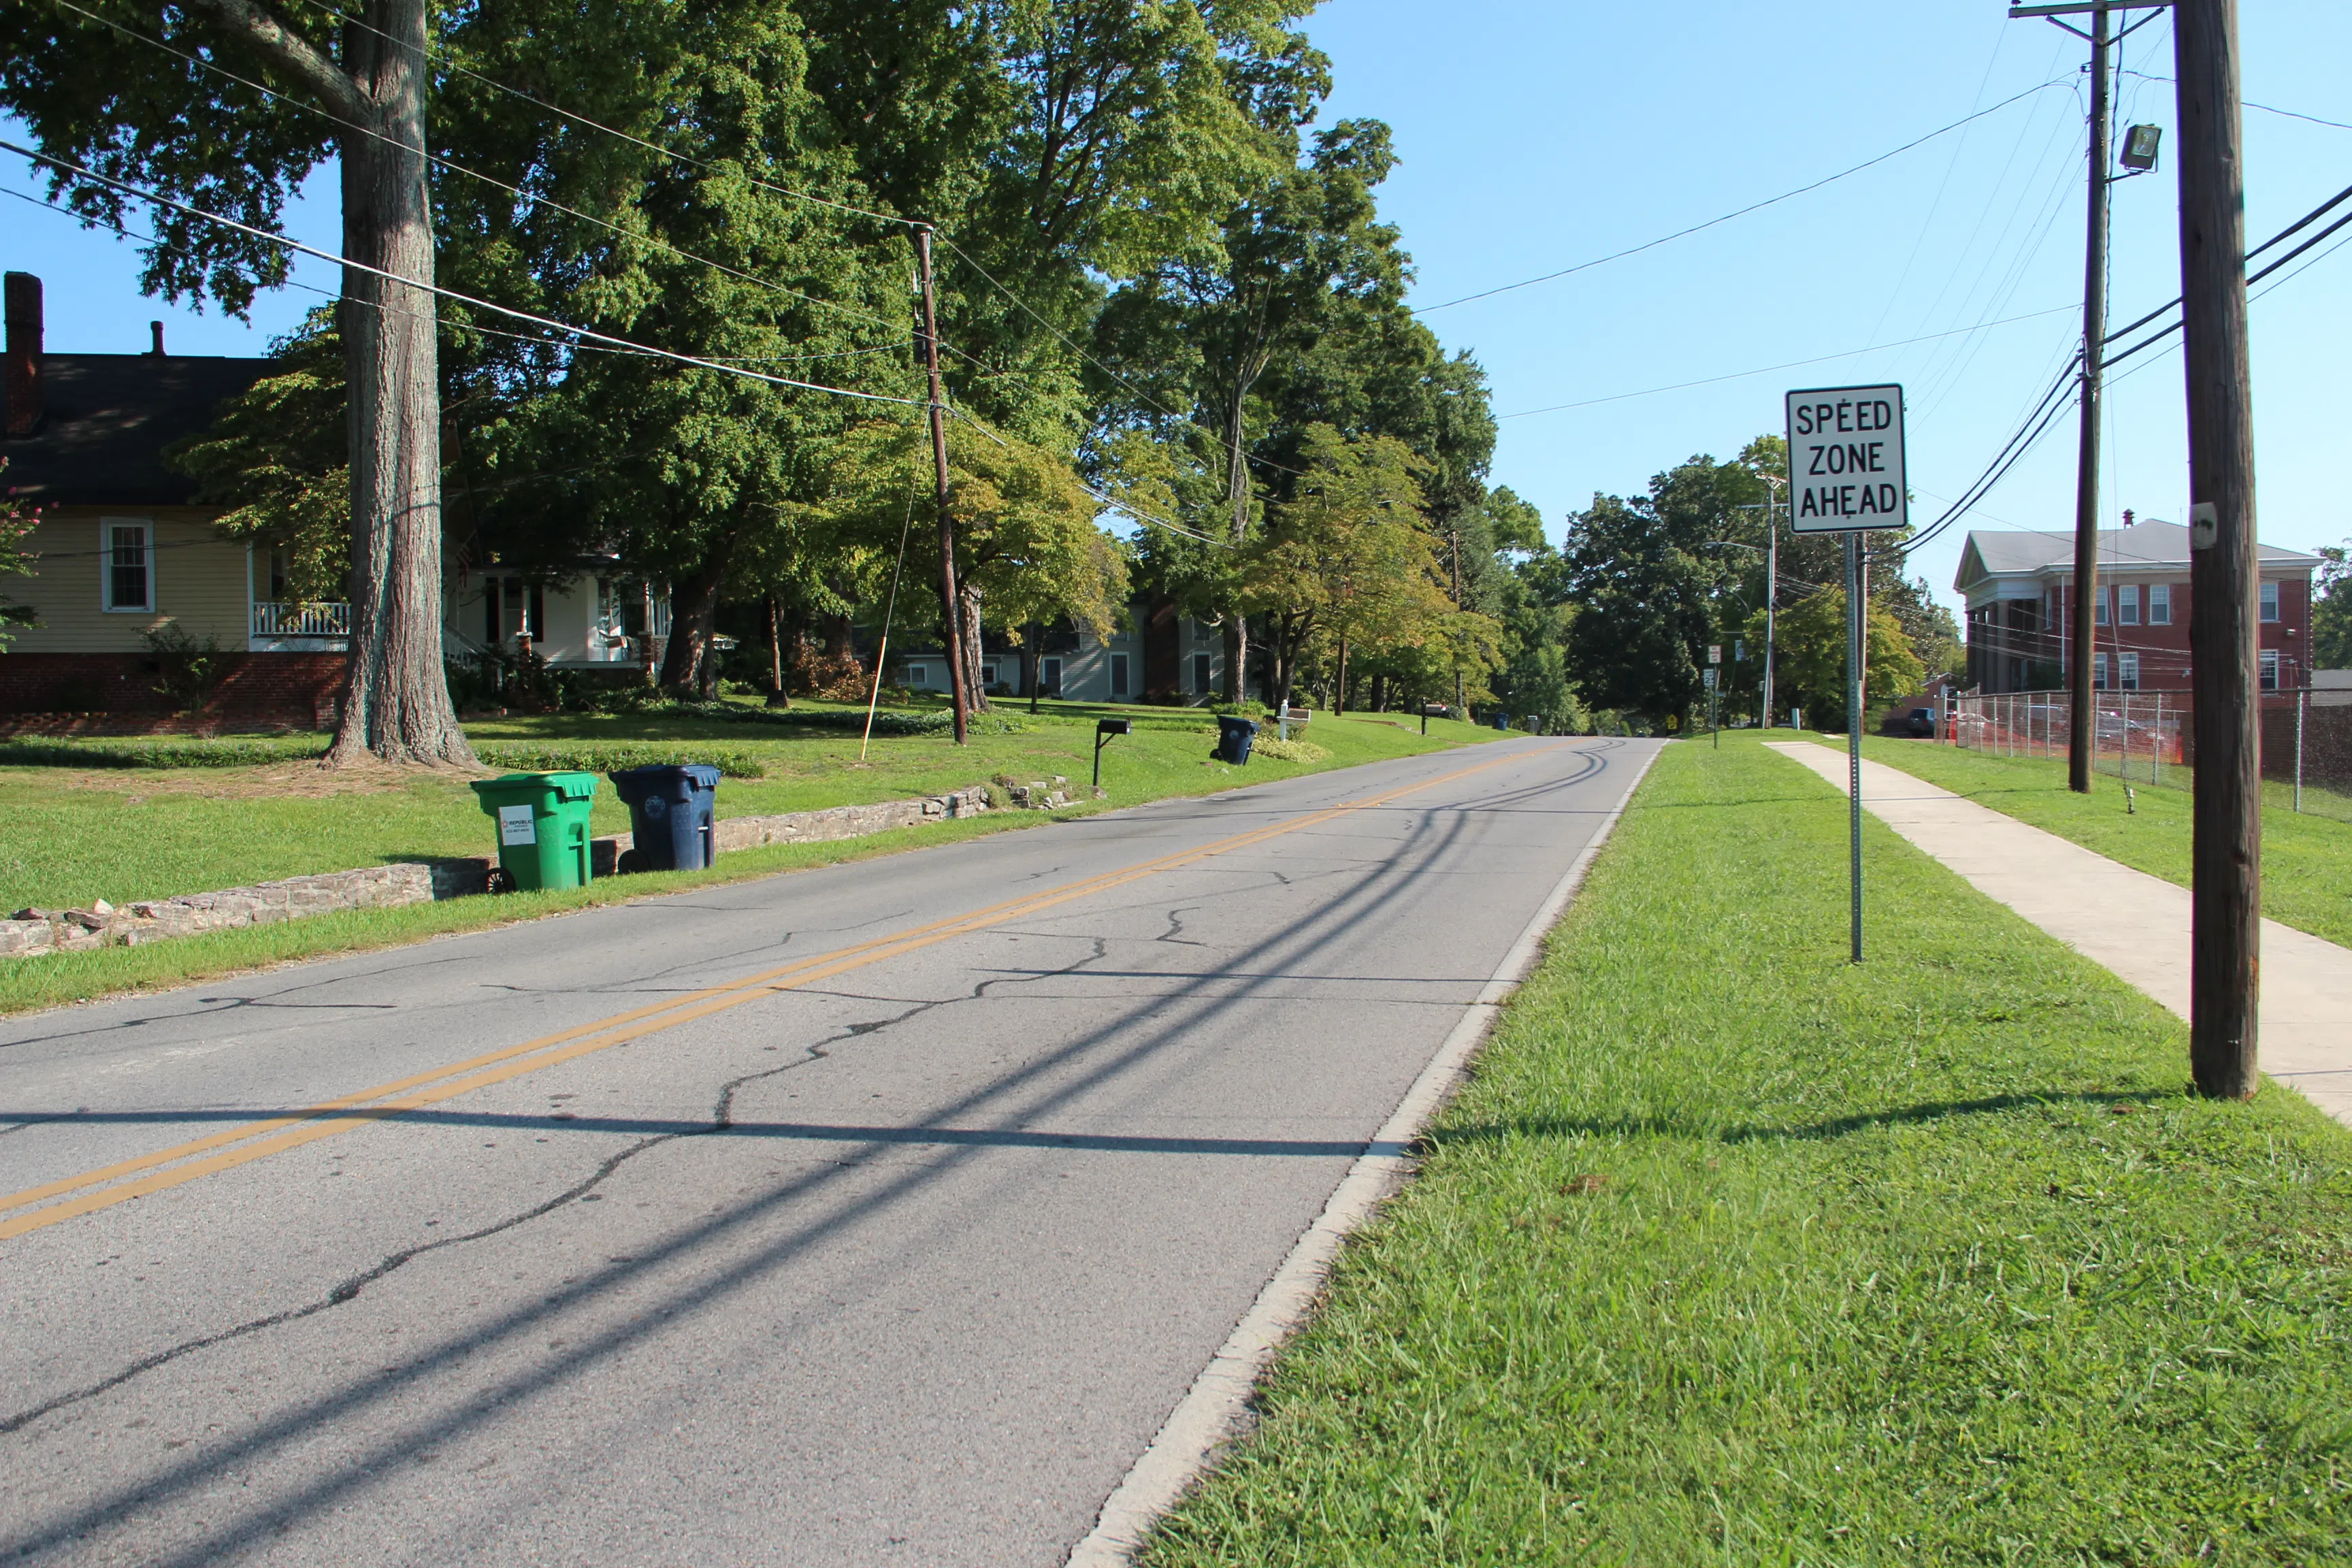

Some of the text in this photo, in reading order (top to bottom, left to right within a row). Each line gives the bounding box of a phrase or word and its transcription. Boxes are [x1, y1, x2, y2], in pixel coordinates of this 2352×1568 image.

[1797, 400, 1891, 436] SPEED
[1809, 442, 1885, 476] ZONE
[1800, 483, 1897, 518] AHEAD
